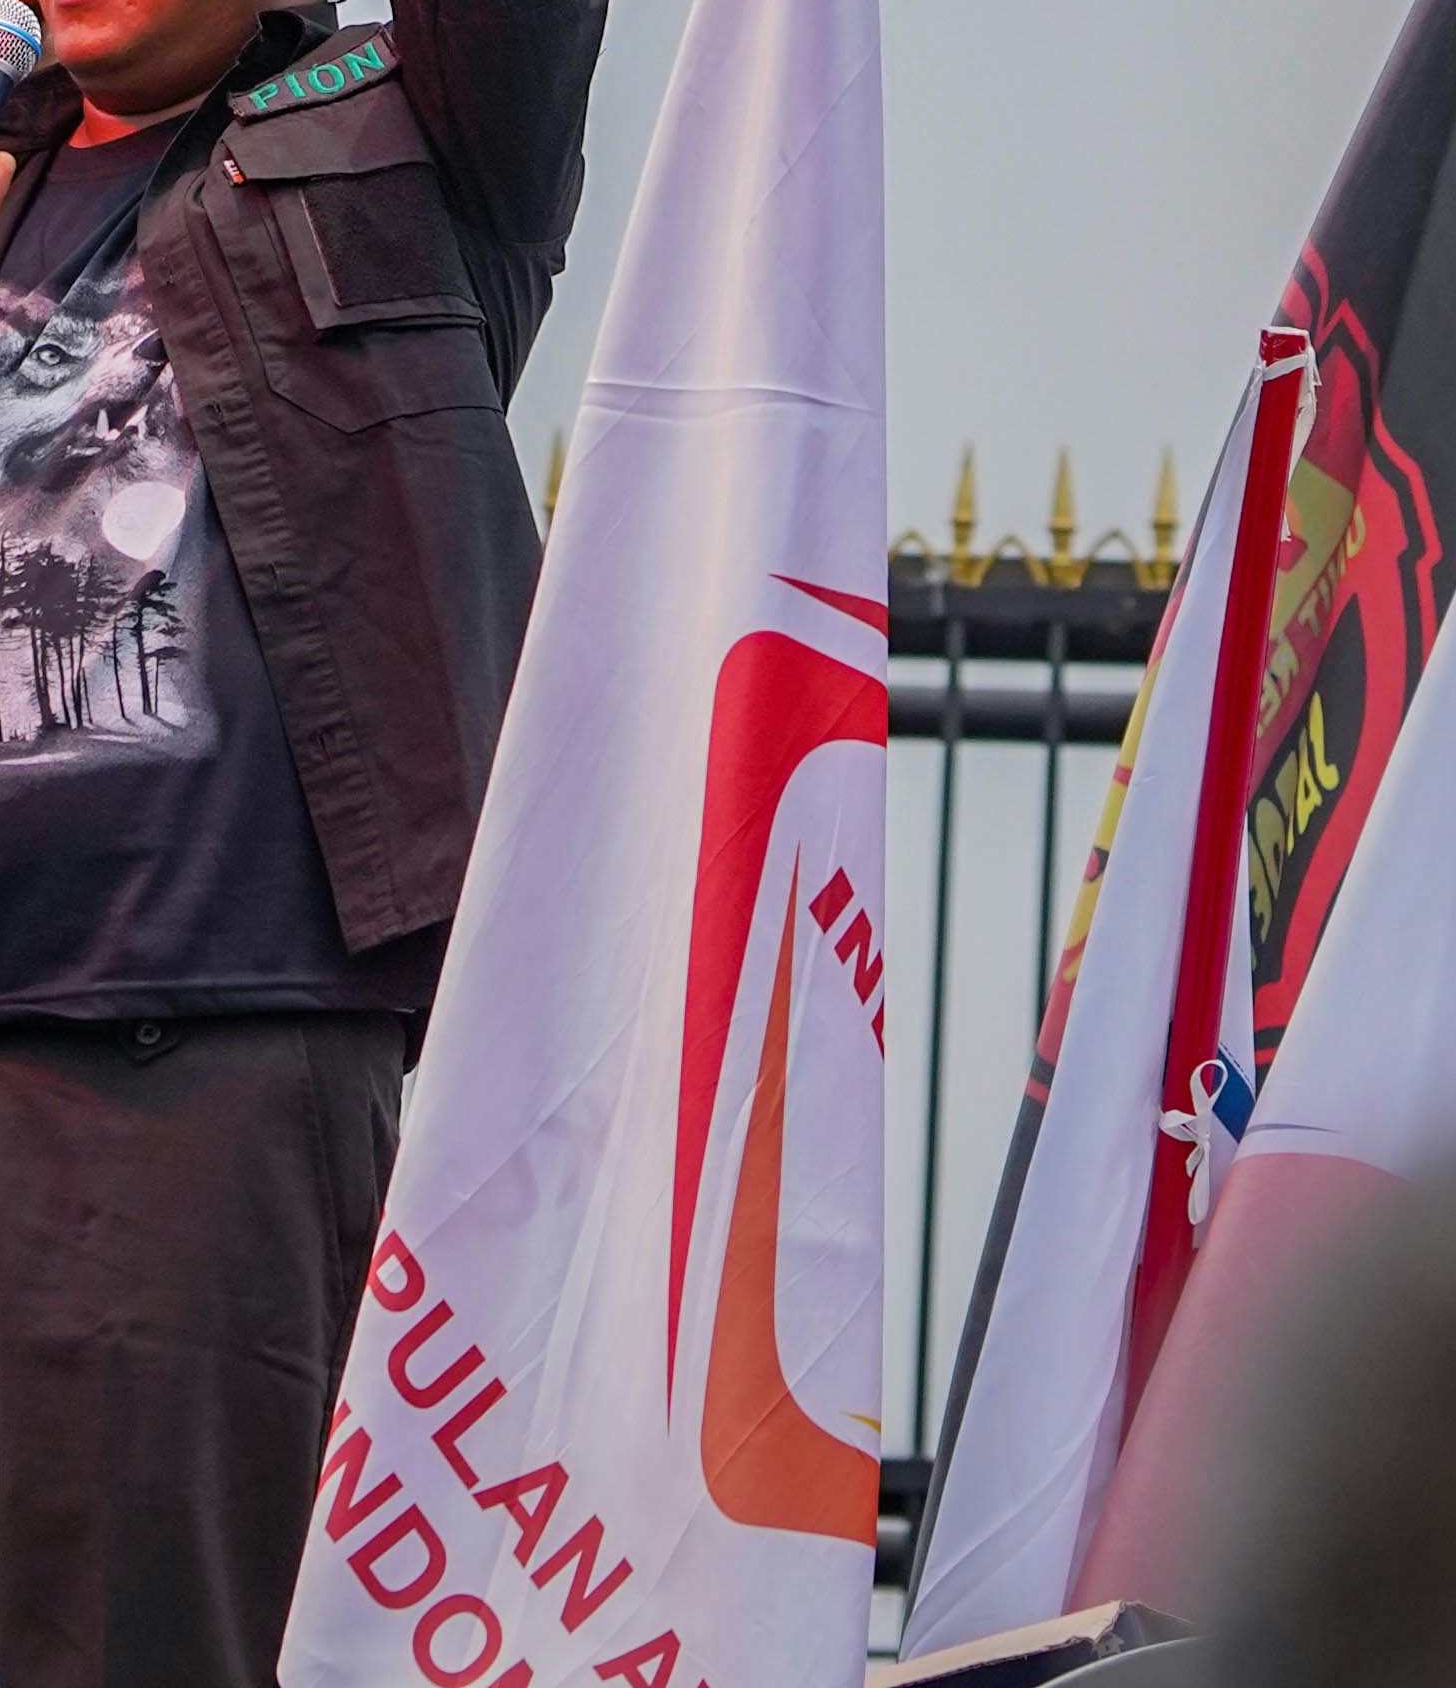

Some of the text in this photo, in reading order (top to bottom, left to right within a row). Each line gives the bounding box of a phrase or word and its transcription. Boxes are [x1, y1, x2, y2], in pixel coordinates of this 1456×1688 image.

[248, 41, 385, 110] PION
[808, 865, 885, 1060] IN
[317, 1399, 534, 1688] NDO
[368, 1208, 710, 1688] PULAN A
